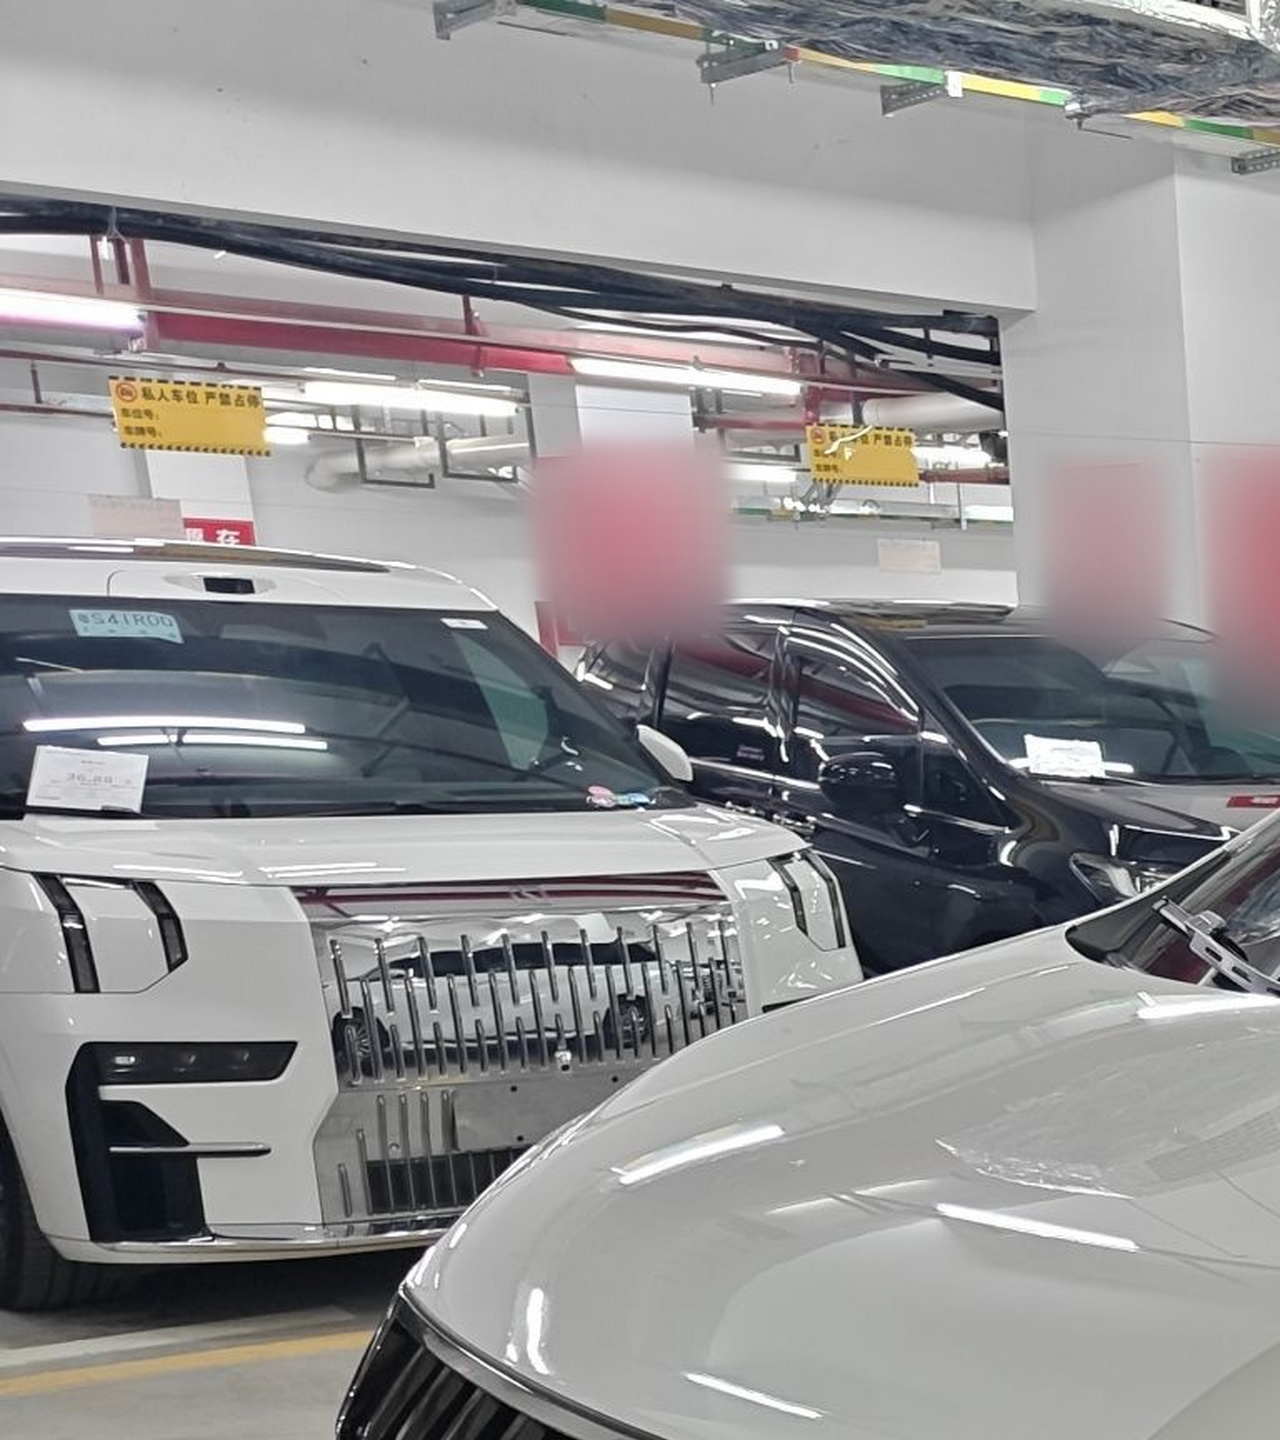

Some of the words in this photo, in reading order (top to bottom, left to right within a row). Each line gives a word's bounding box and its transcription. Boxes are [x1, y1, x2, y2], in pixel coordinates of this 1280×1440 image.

[141, 386, 198, 404] 私人车位
[204, 391, 261, 409] 严禁占停
